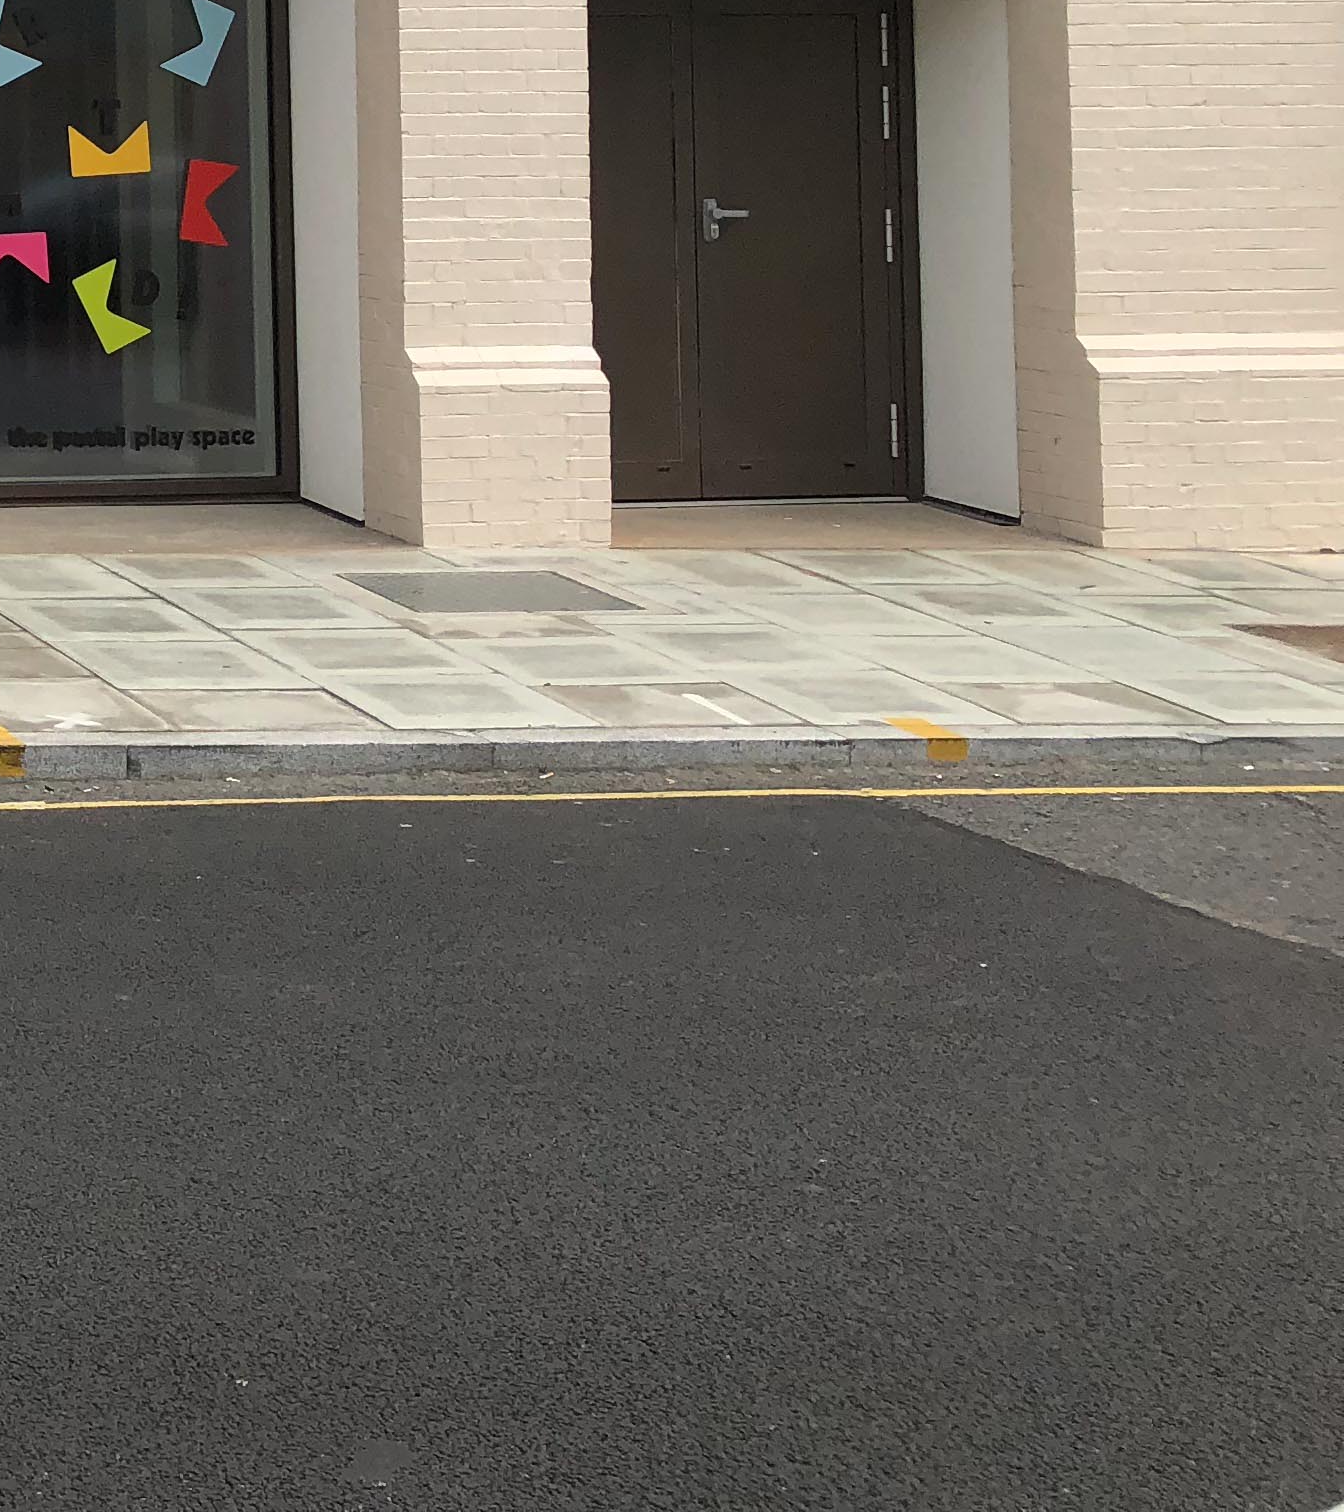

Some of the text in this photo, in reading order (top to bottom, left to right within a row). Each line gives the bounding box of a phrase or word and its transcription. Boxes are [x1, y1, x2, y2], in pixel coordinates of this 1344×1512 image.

[6, 427, 48, 449] the
[134, 426, 185, 451] play
[191, 427, 255, 451] space
